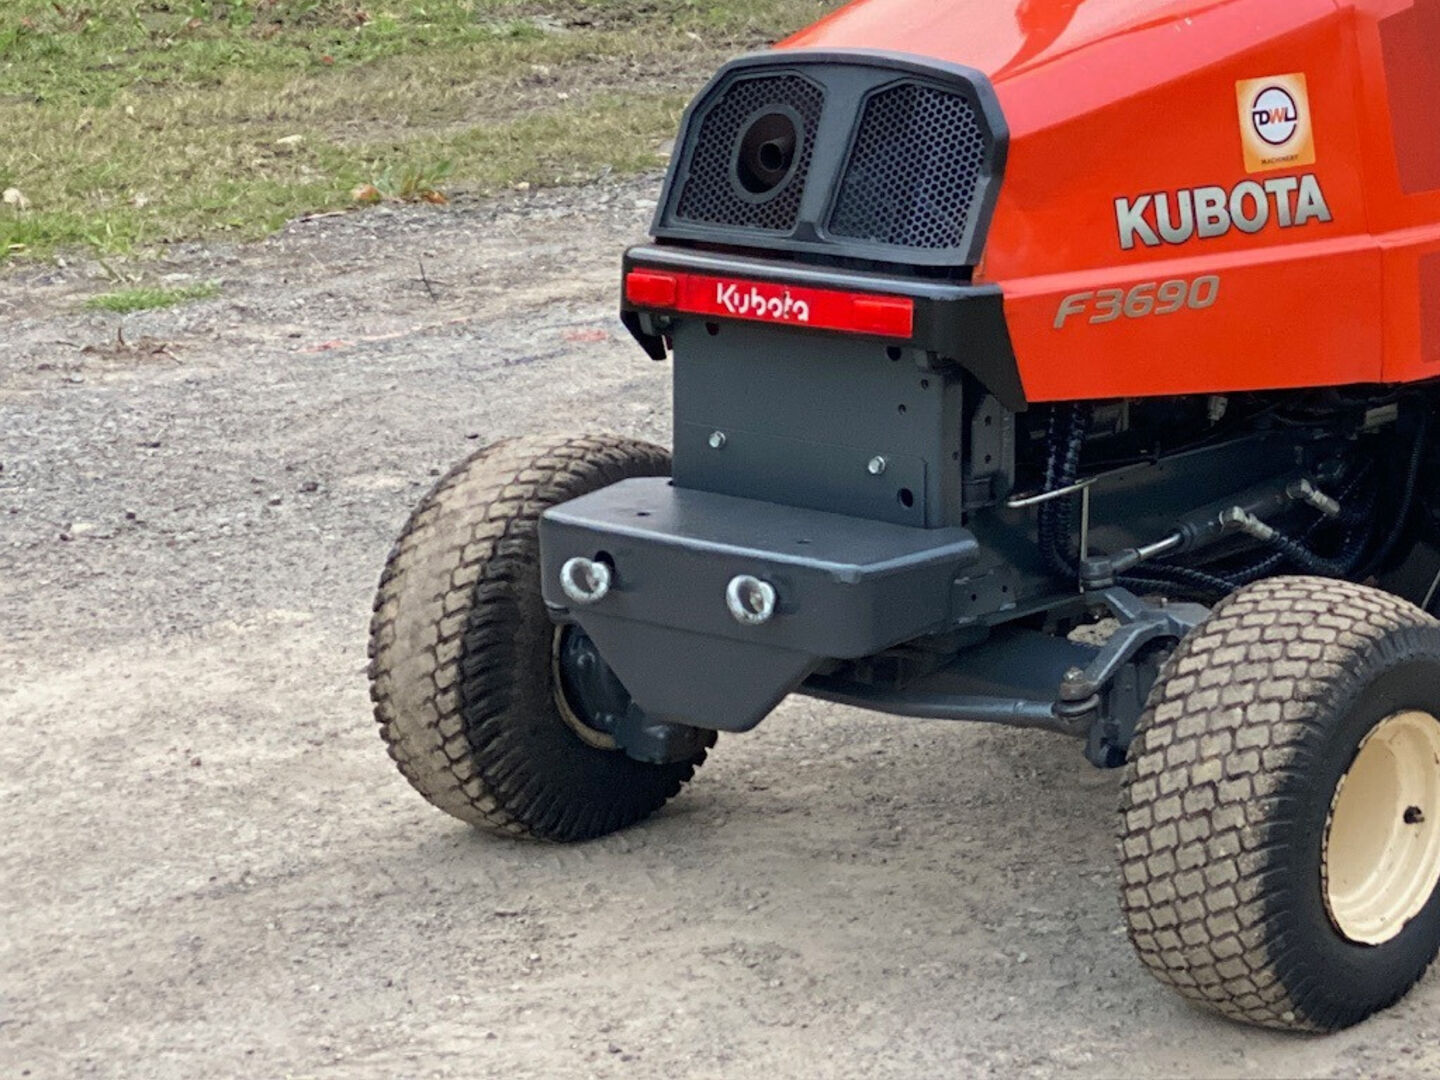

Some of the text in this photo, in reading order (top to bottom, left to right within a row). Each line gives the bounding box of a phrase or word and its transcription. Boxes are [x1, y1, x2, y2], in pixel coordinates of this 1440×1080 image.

[1114, 174, 1332, 250] KUBOTA
[716, 282, 809, 322] Kubota
[1053, 275, 1221, 329] F3690
